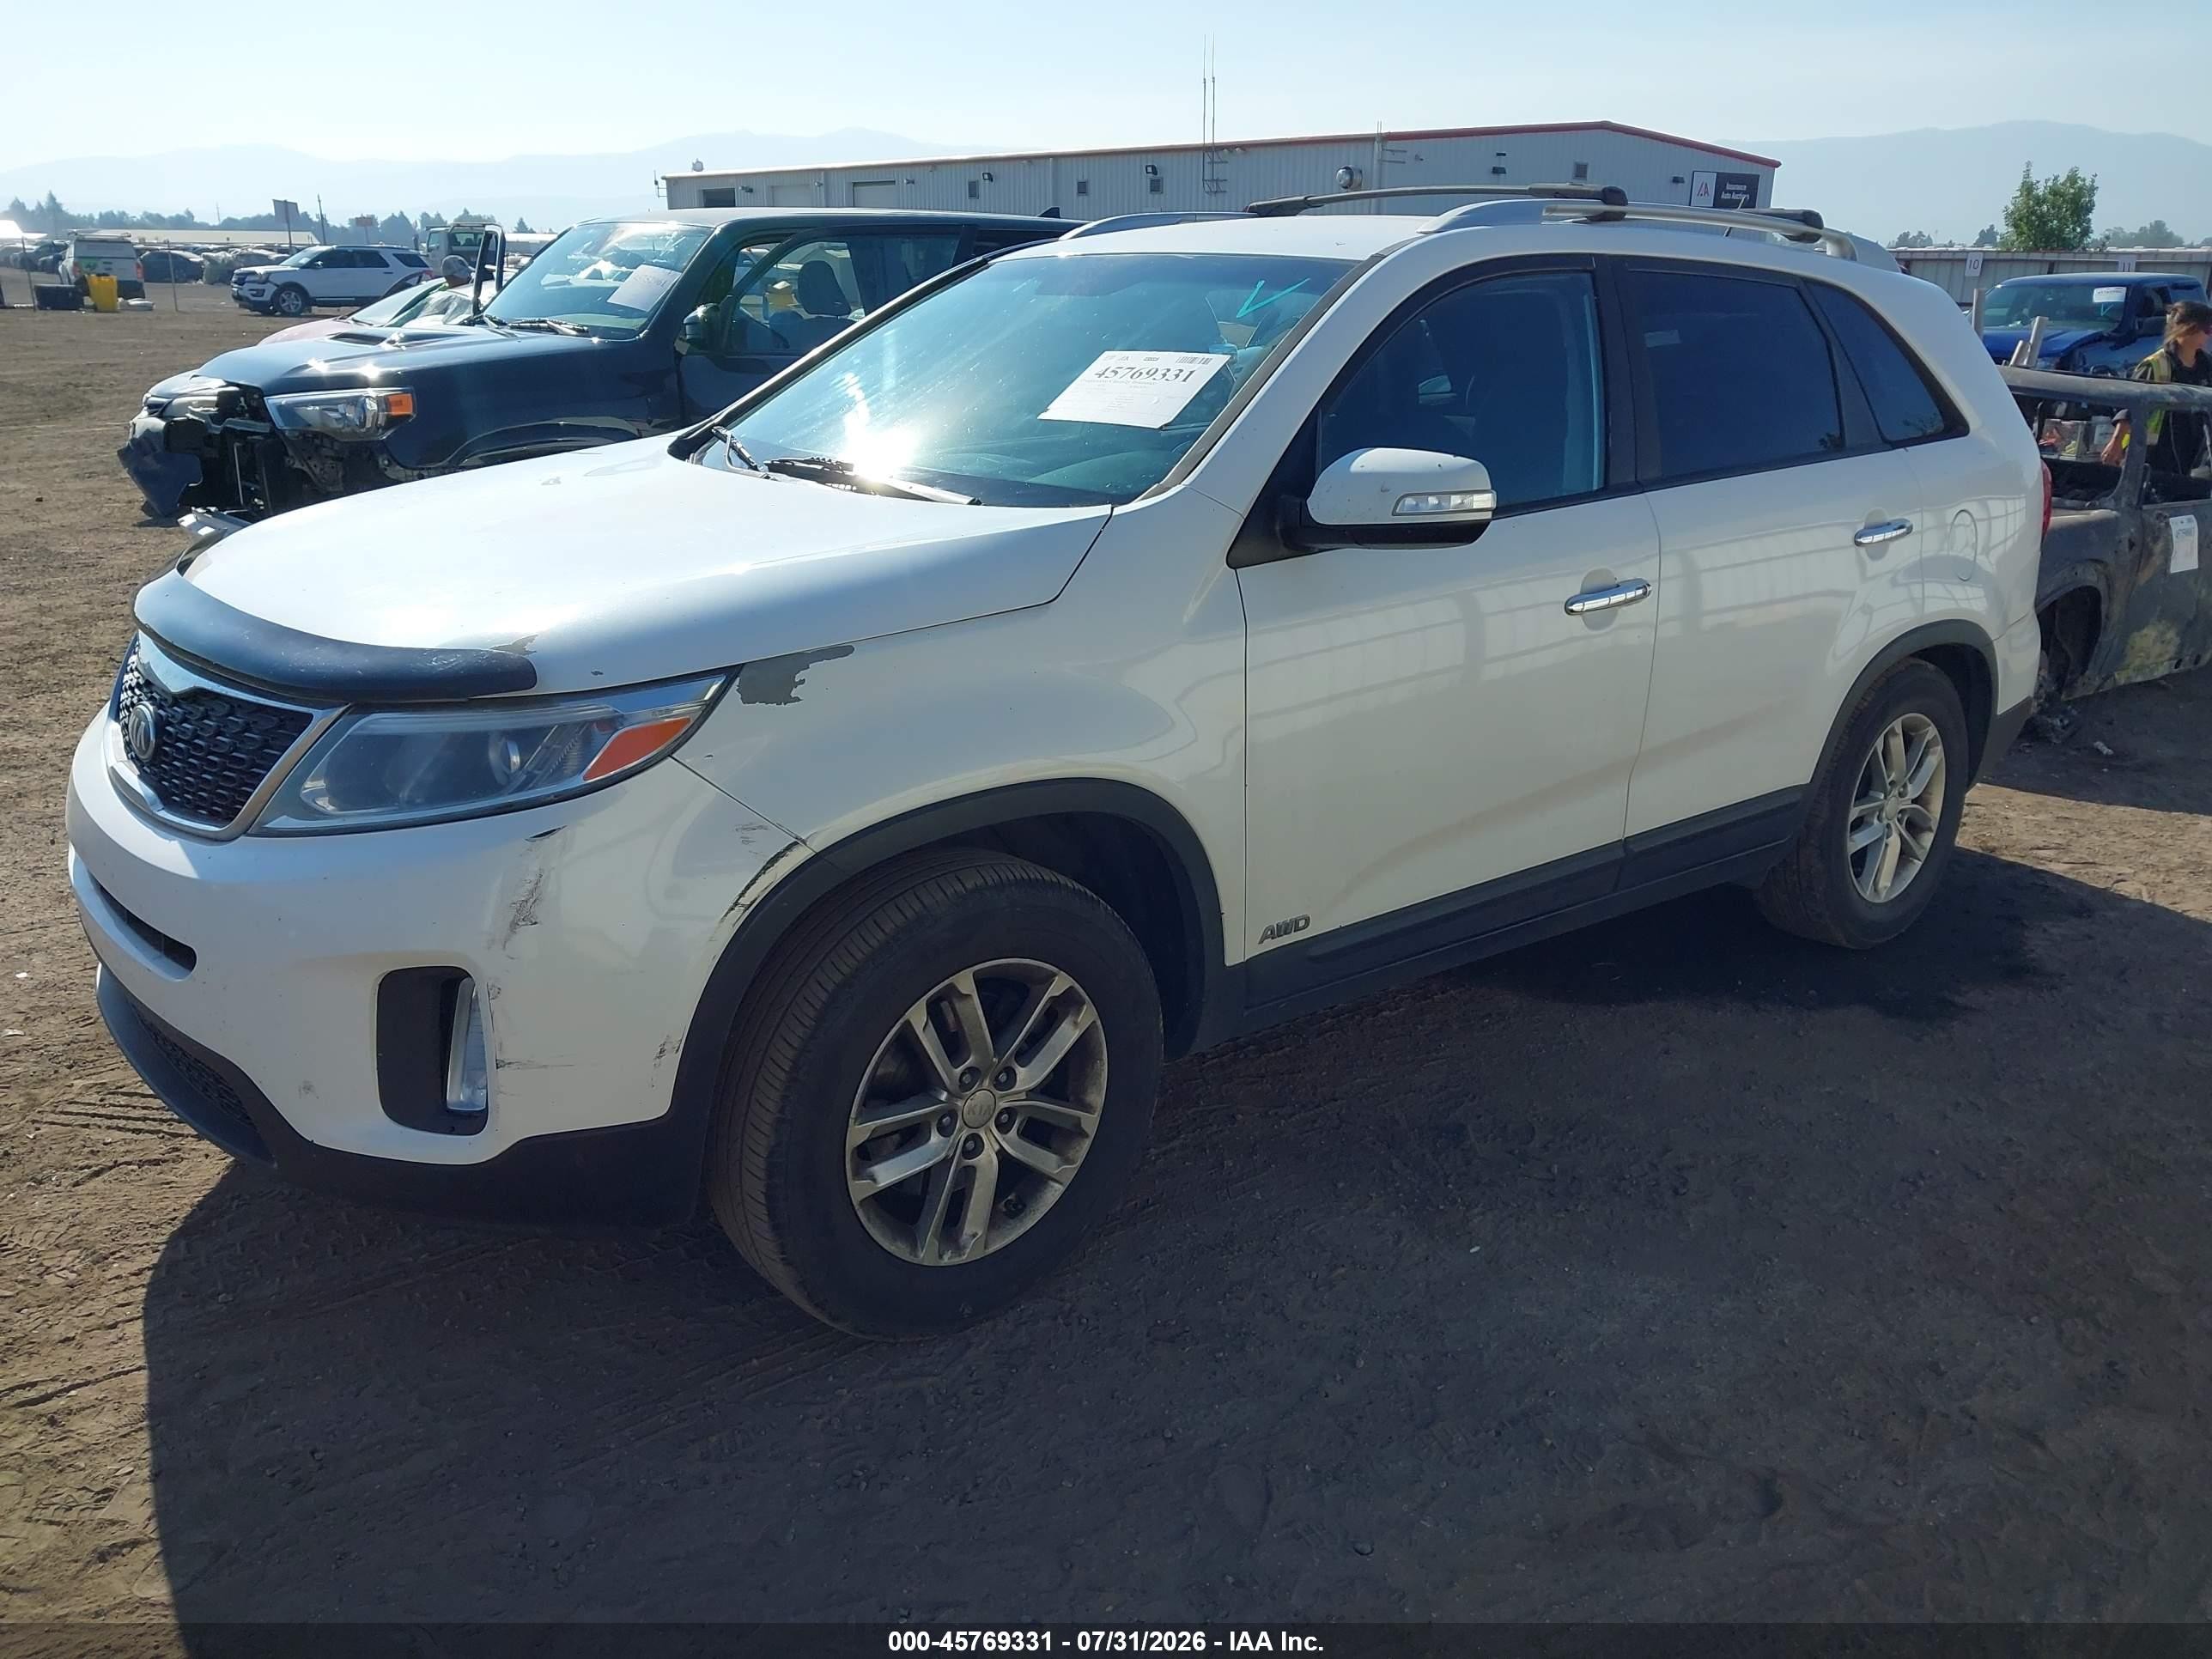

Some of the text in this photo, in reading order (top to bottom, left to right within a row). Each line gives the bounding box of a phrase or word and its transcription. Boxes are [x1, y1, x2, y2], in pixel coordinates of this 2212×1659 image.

[1969, 259, 1978, 270] 10
[1094, 366, 1196, 383] 45769331
[1257, 914, 1310, 945] AWD
